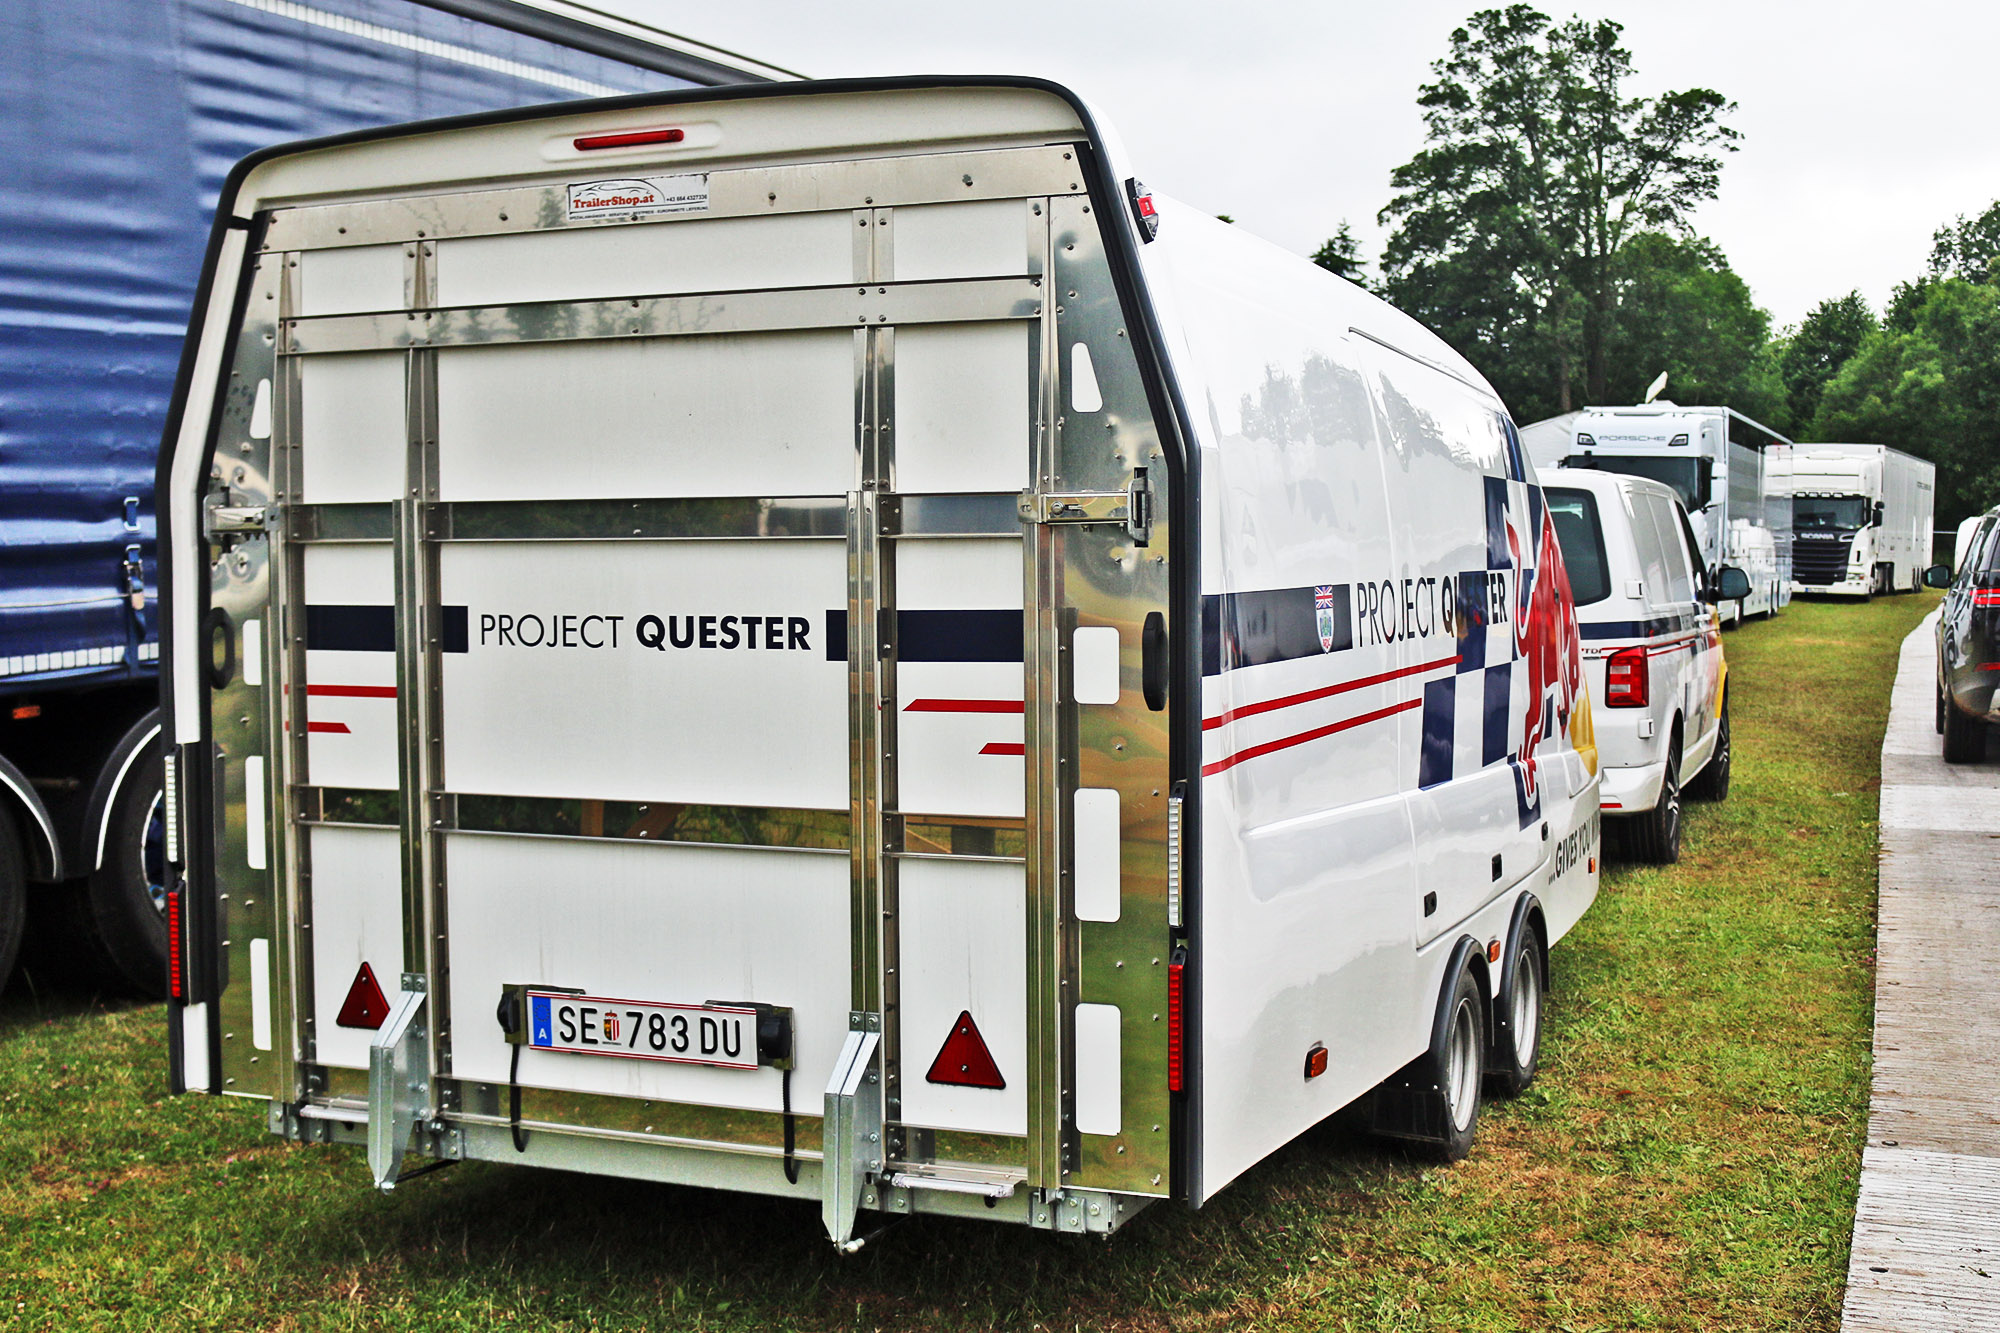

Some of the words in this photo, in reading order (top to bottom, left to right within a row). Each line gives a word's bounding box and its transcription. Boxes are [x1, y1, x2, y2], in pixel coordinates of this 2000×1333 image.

[573, 194, 655, 209] TrailerShop.at
[1800, 532, 1835, 540] SCANIA
[1356, 576, 1436, 648] PROJECT
[480, 614, 624, 648] PROJECT
[635, 614, 812, 652] QUESTER
[538, 1028, 548, 1040] A
[558, 1005, 599, 1044] SE
